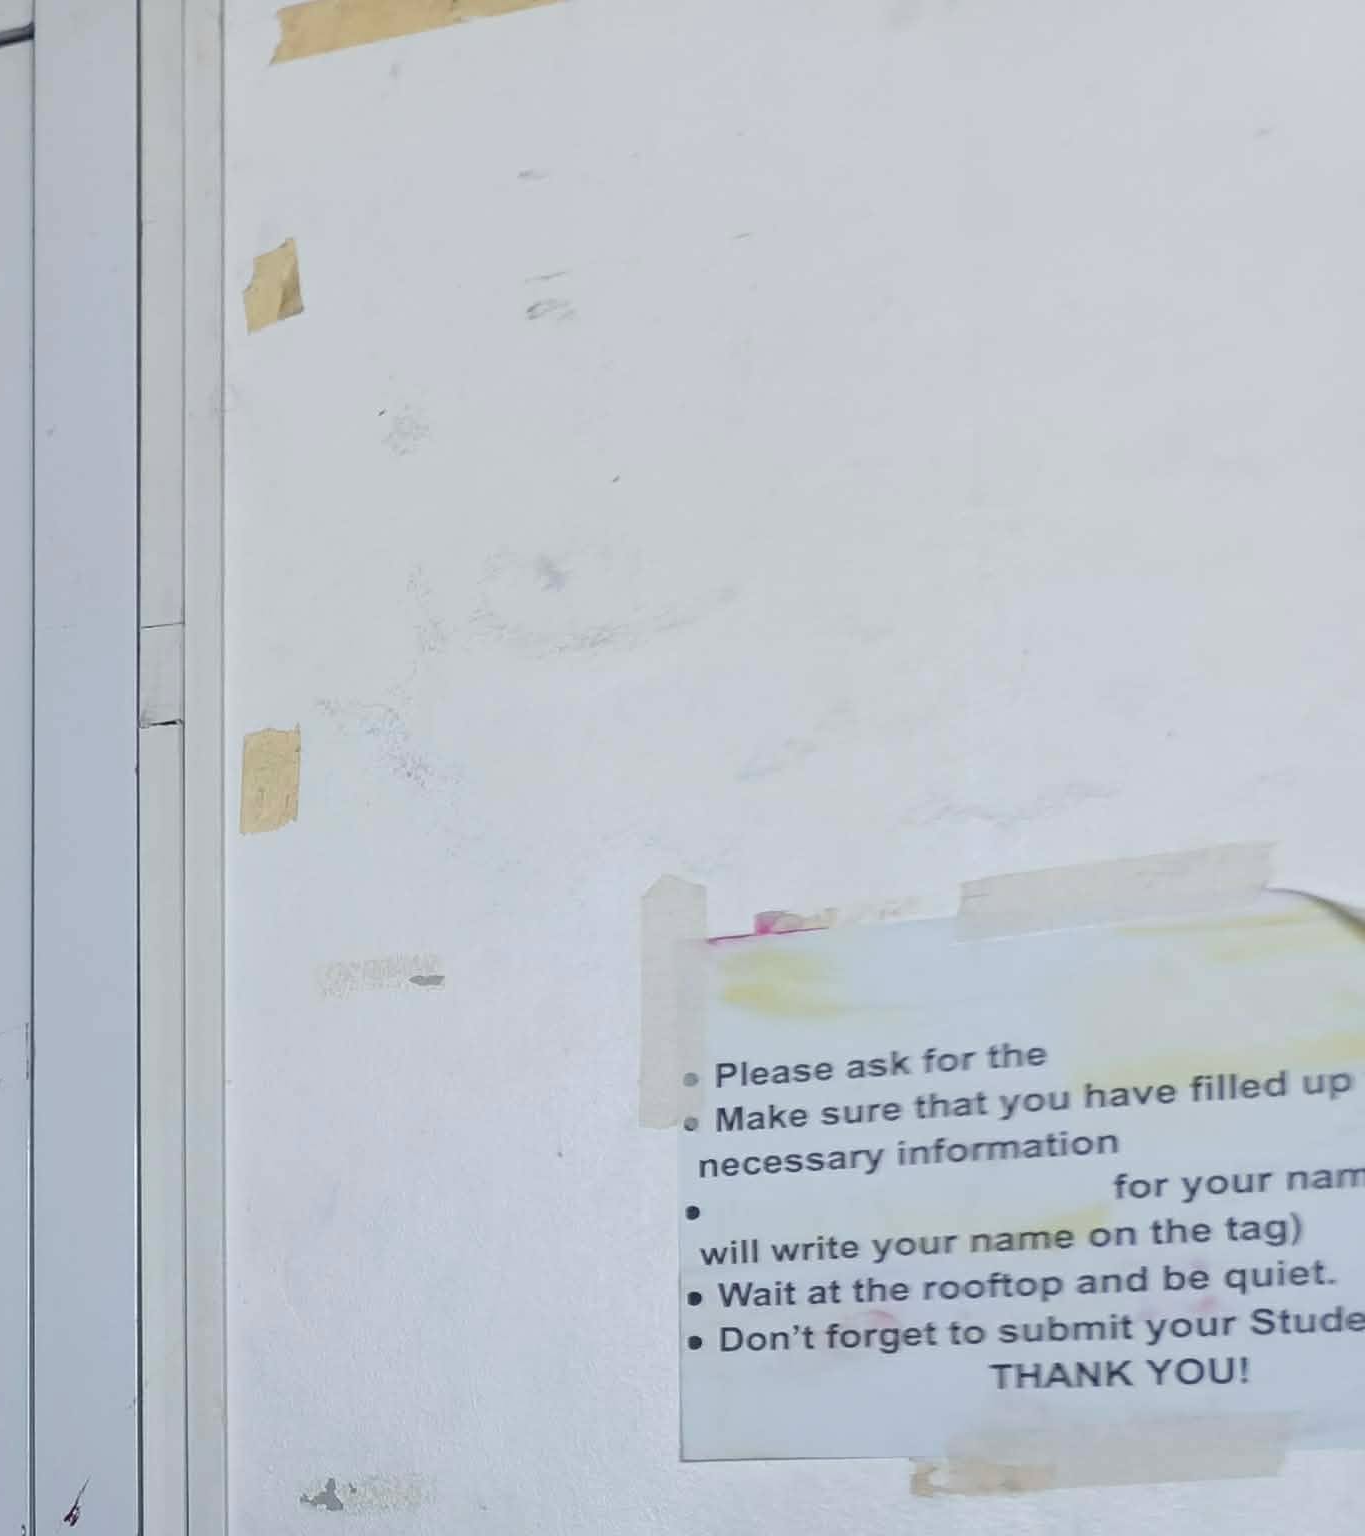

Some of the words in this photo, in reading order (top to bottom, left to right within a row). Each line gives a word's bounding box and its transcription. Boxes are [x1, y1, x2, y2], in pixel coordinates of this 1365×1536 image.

[715, 1061, 833, 1088] Please
[847, 1051, 910, 1079] ask
[923, 1048, 975, 1073] for
[987, 1043, 1046, 1068] the
[716, 1105, 808, 1132] Make
[821, 1101, 902, 1125] sure
[915, 1092, 987, 1119] that
[1000, 1091, 1069, 1120] you
[1085, 1083, 1176, 1108] have
[1190, 1070, 1287, 1101] filled
[1303, 1072, 1354, 1100] up
[699, 1148, 884, 1177] necessary
[897, 1132, 1118, 1166] information
[1114, 1173, 1168, 1199] for
[1181, 1172, 1272, 1203] your
[700, 1239, 758, 1265] will
[772, 1236, 859, 1261] write
[872, 1234, 957, 1263] your
[970, 1229, 1074, 1252] name
[1090, 1226, 1137, 1247] on
[1152, 1219, 1211, 1244] the
[1226, 1213, 1302, 1246] tag)
[718, 1281, 796, 1307] Wait
[807, 1280, 841, 1304] at
[853, 1277, 910, 1302] the
[923, 1273, 1062, 1301] rooftop
[1077, 1267, 1147, 1295] and
[1164, 1266, 1209, 1291] be
[1225, 1261, 1337, 1294] quiet.
[720, 1325, 815, 1352] Don't
[826, 1323, 936, 1353] forget
[950, 1322, 985, 1346] to
[998, 1314, 1133, 1344] submit
[1146, 1315, 1237, 1345] your
[989, 1360, 1133, 1390] THANK
[1147, 1356, 1249, 1386] YOU!
